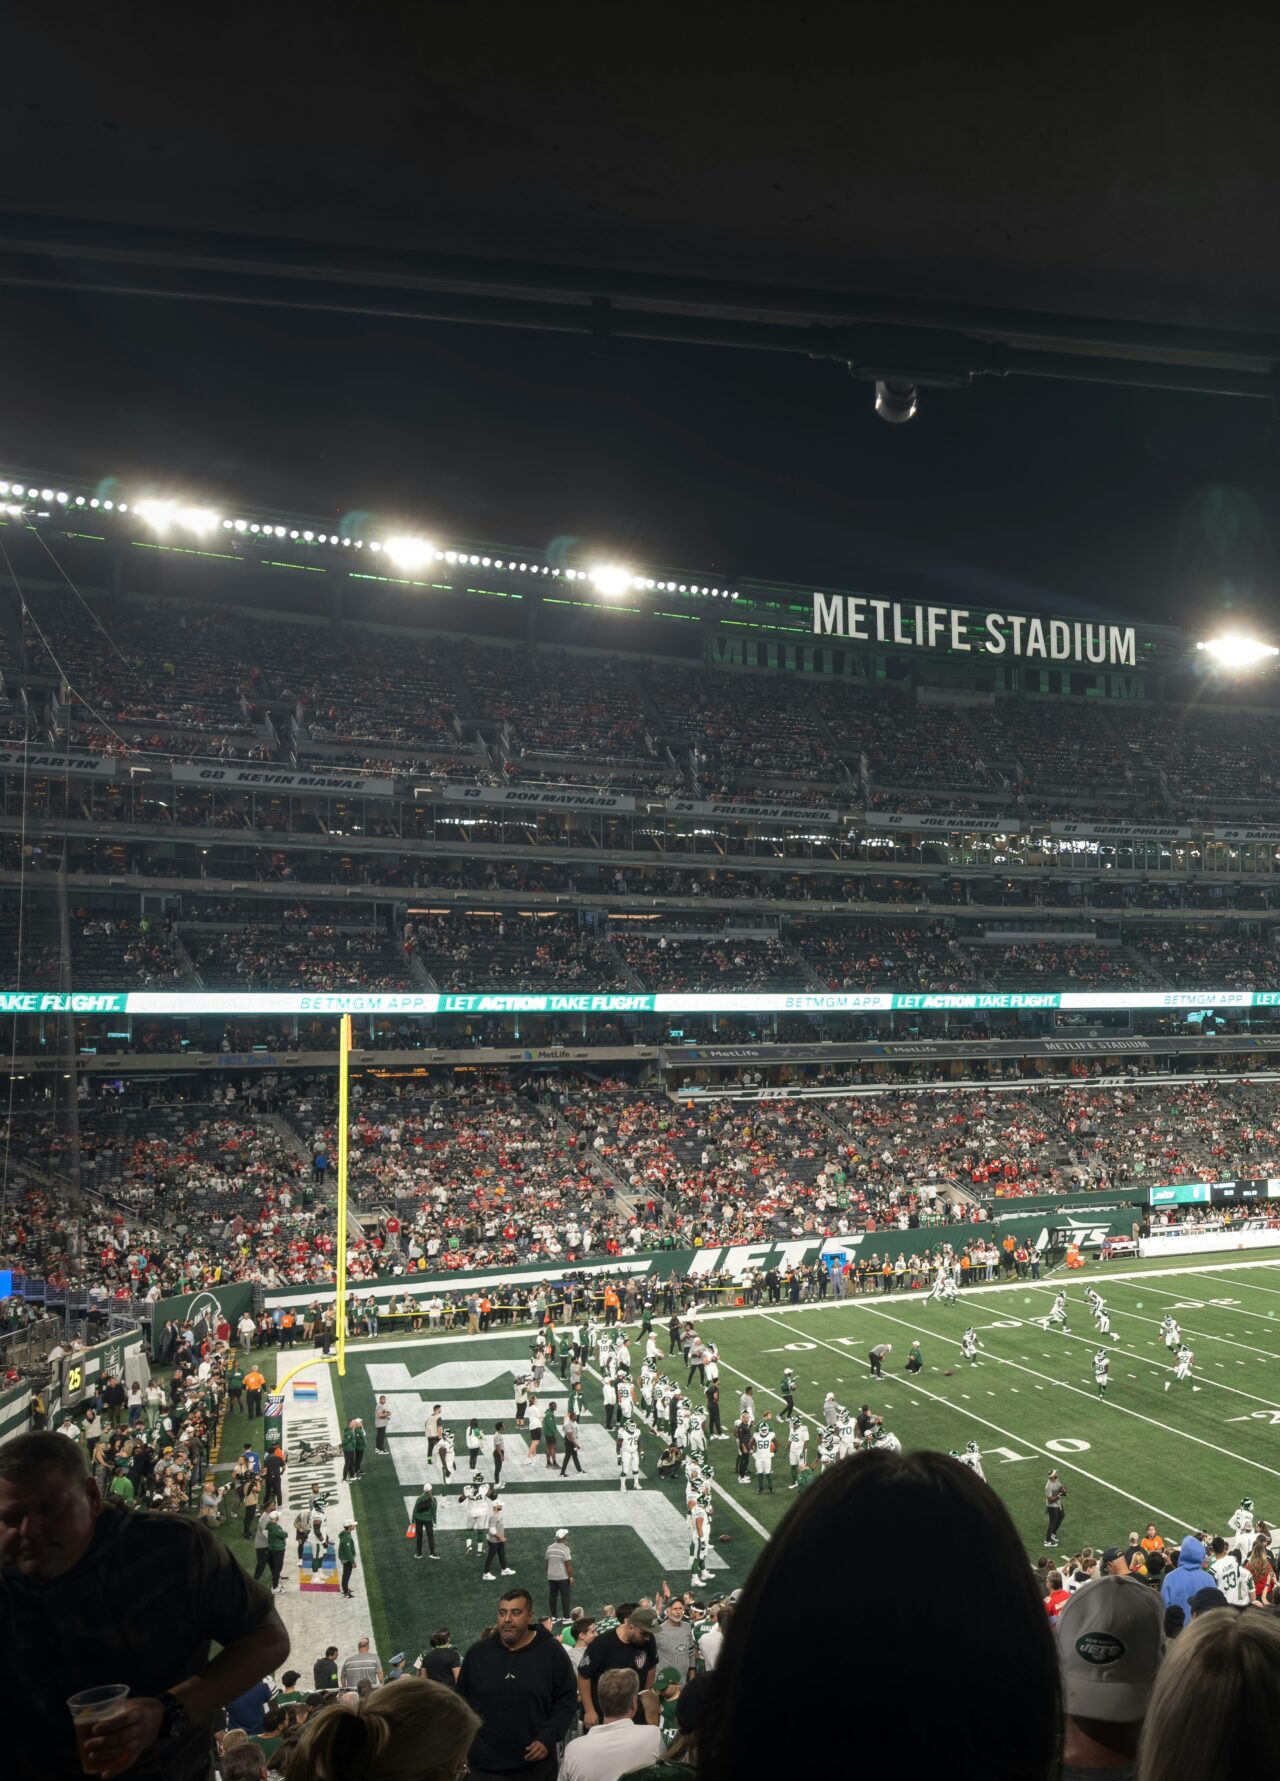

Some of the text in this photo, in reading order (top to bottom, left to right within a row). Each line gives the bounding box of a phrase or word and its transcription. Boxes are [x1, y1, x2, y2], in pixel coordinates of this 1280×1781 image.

[813, 592, 1136, 666] METLIFE STADIUM
[15, 755, 99, 770] MARTIN
[200, 770, 365, 789] 68 KEVIN MAWAE
[463, 789, 616, 806] 13 DON MAYNARD
[674, 802, 694, 811] 24
[712, 805, 778, 816] FREEMAN
[887, 816, 999, 828] 12 JOE NAMATH
[39, 995, 120, 1011] FLIGHT.
[301, 998, 381, 1010] BETMGM
[387, 998, 427, 1010] APP.
[445, 997, 477, 1010] LET
[478, 997, 547, 1011] ACTION
[549, 997, 590, 1010] TAKE
[591, 996, 650, 1010] FLIGHT.
[786, 997, 847, 1008] BETMGM
[897, 995, 1057, 1008] LET ACTION TAKE FLIGHT.
[1164, 995, 1216, 1004] BETMGM
[1256, 993, 1275, 1004] LET
[1044, 1040, 1150, 1051] METLIFE STADIUM
[538, 1050, 570, 1058] MetLife
[710, 1049, 760, 1057] MetLife
[68, 1366, 81, 1391] 25
[757, 1440, 769, 1451] 58
[981, 1438, 1091, 1463] 10
[1222, 1571, 1238, 1591] 33
[1080, 1643, 1121, 1656] JETS
